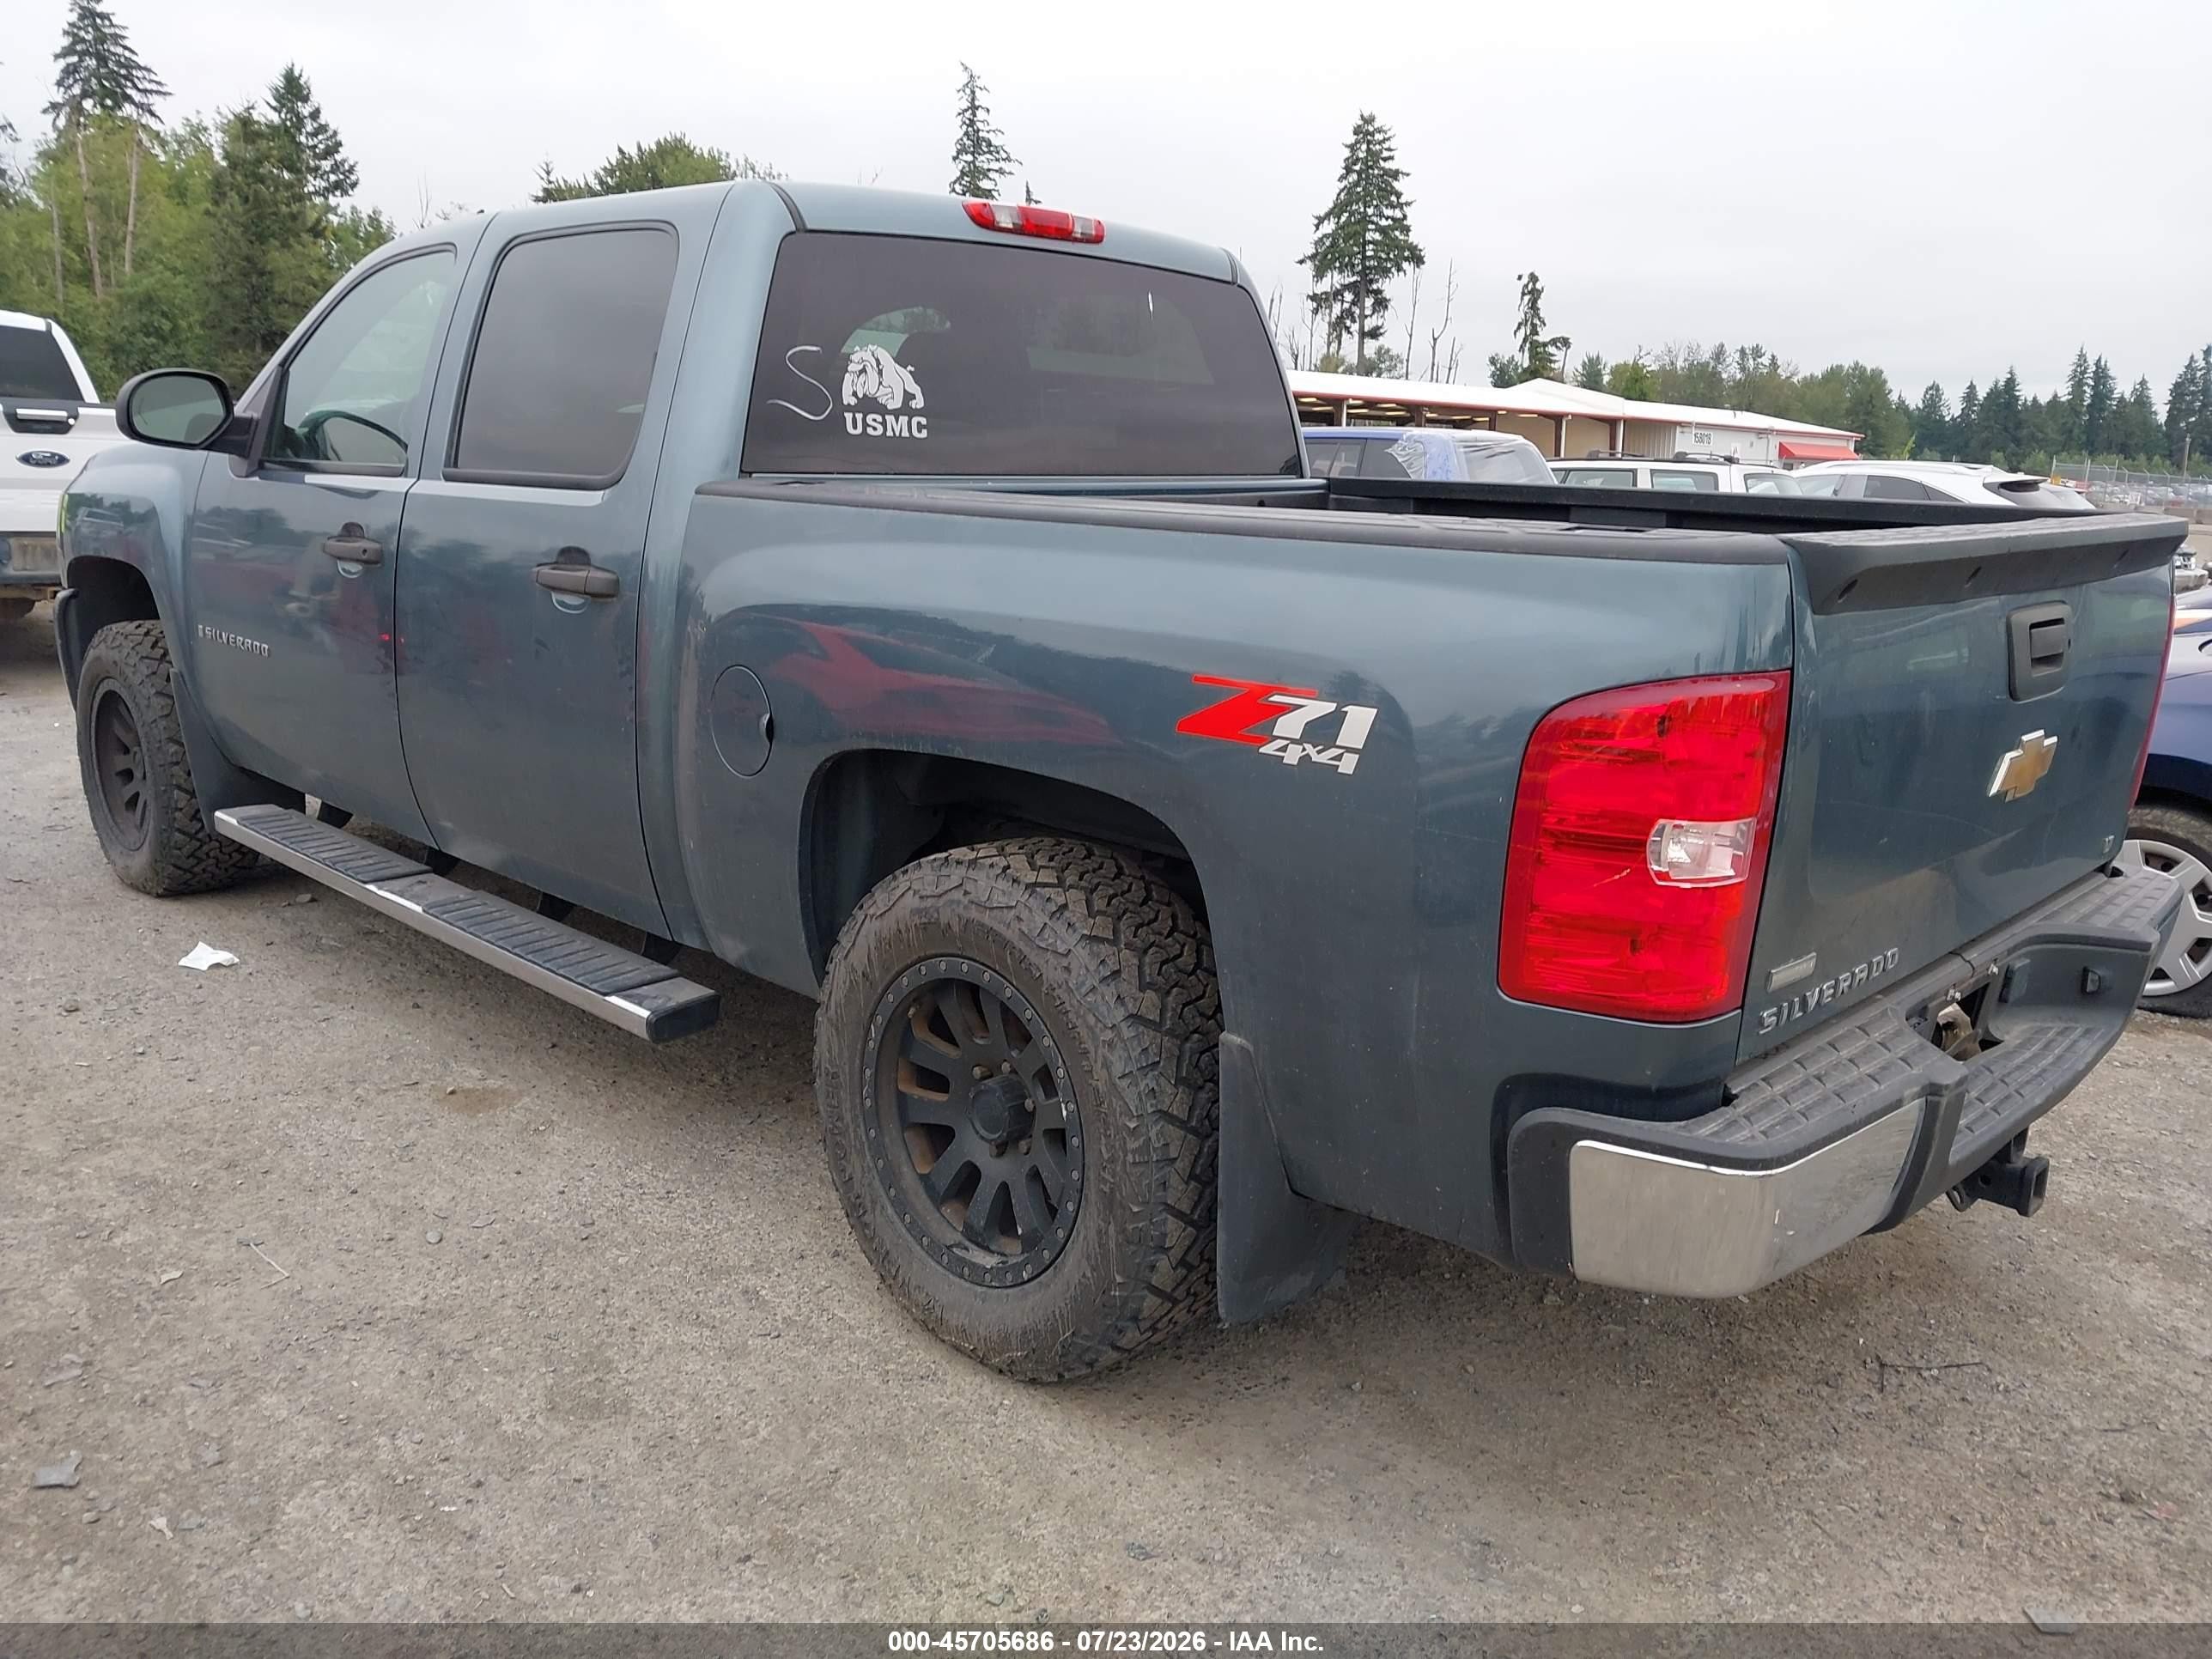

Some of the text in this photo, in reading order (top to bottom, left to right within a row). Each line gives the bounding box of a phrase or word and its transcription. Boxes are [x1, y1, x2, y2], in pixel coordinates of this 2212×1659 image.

[844, 412, 928, 439] USMC
[205, 627, 269, 659] SILVERADO
[1176, 673, 1378, 750] Z71
[1759, 947, 1899, 1035] SILVERADO
